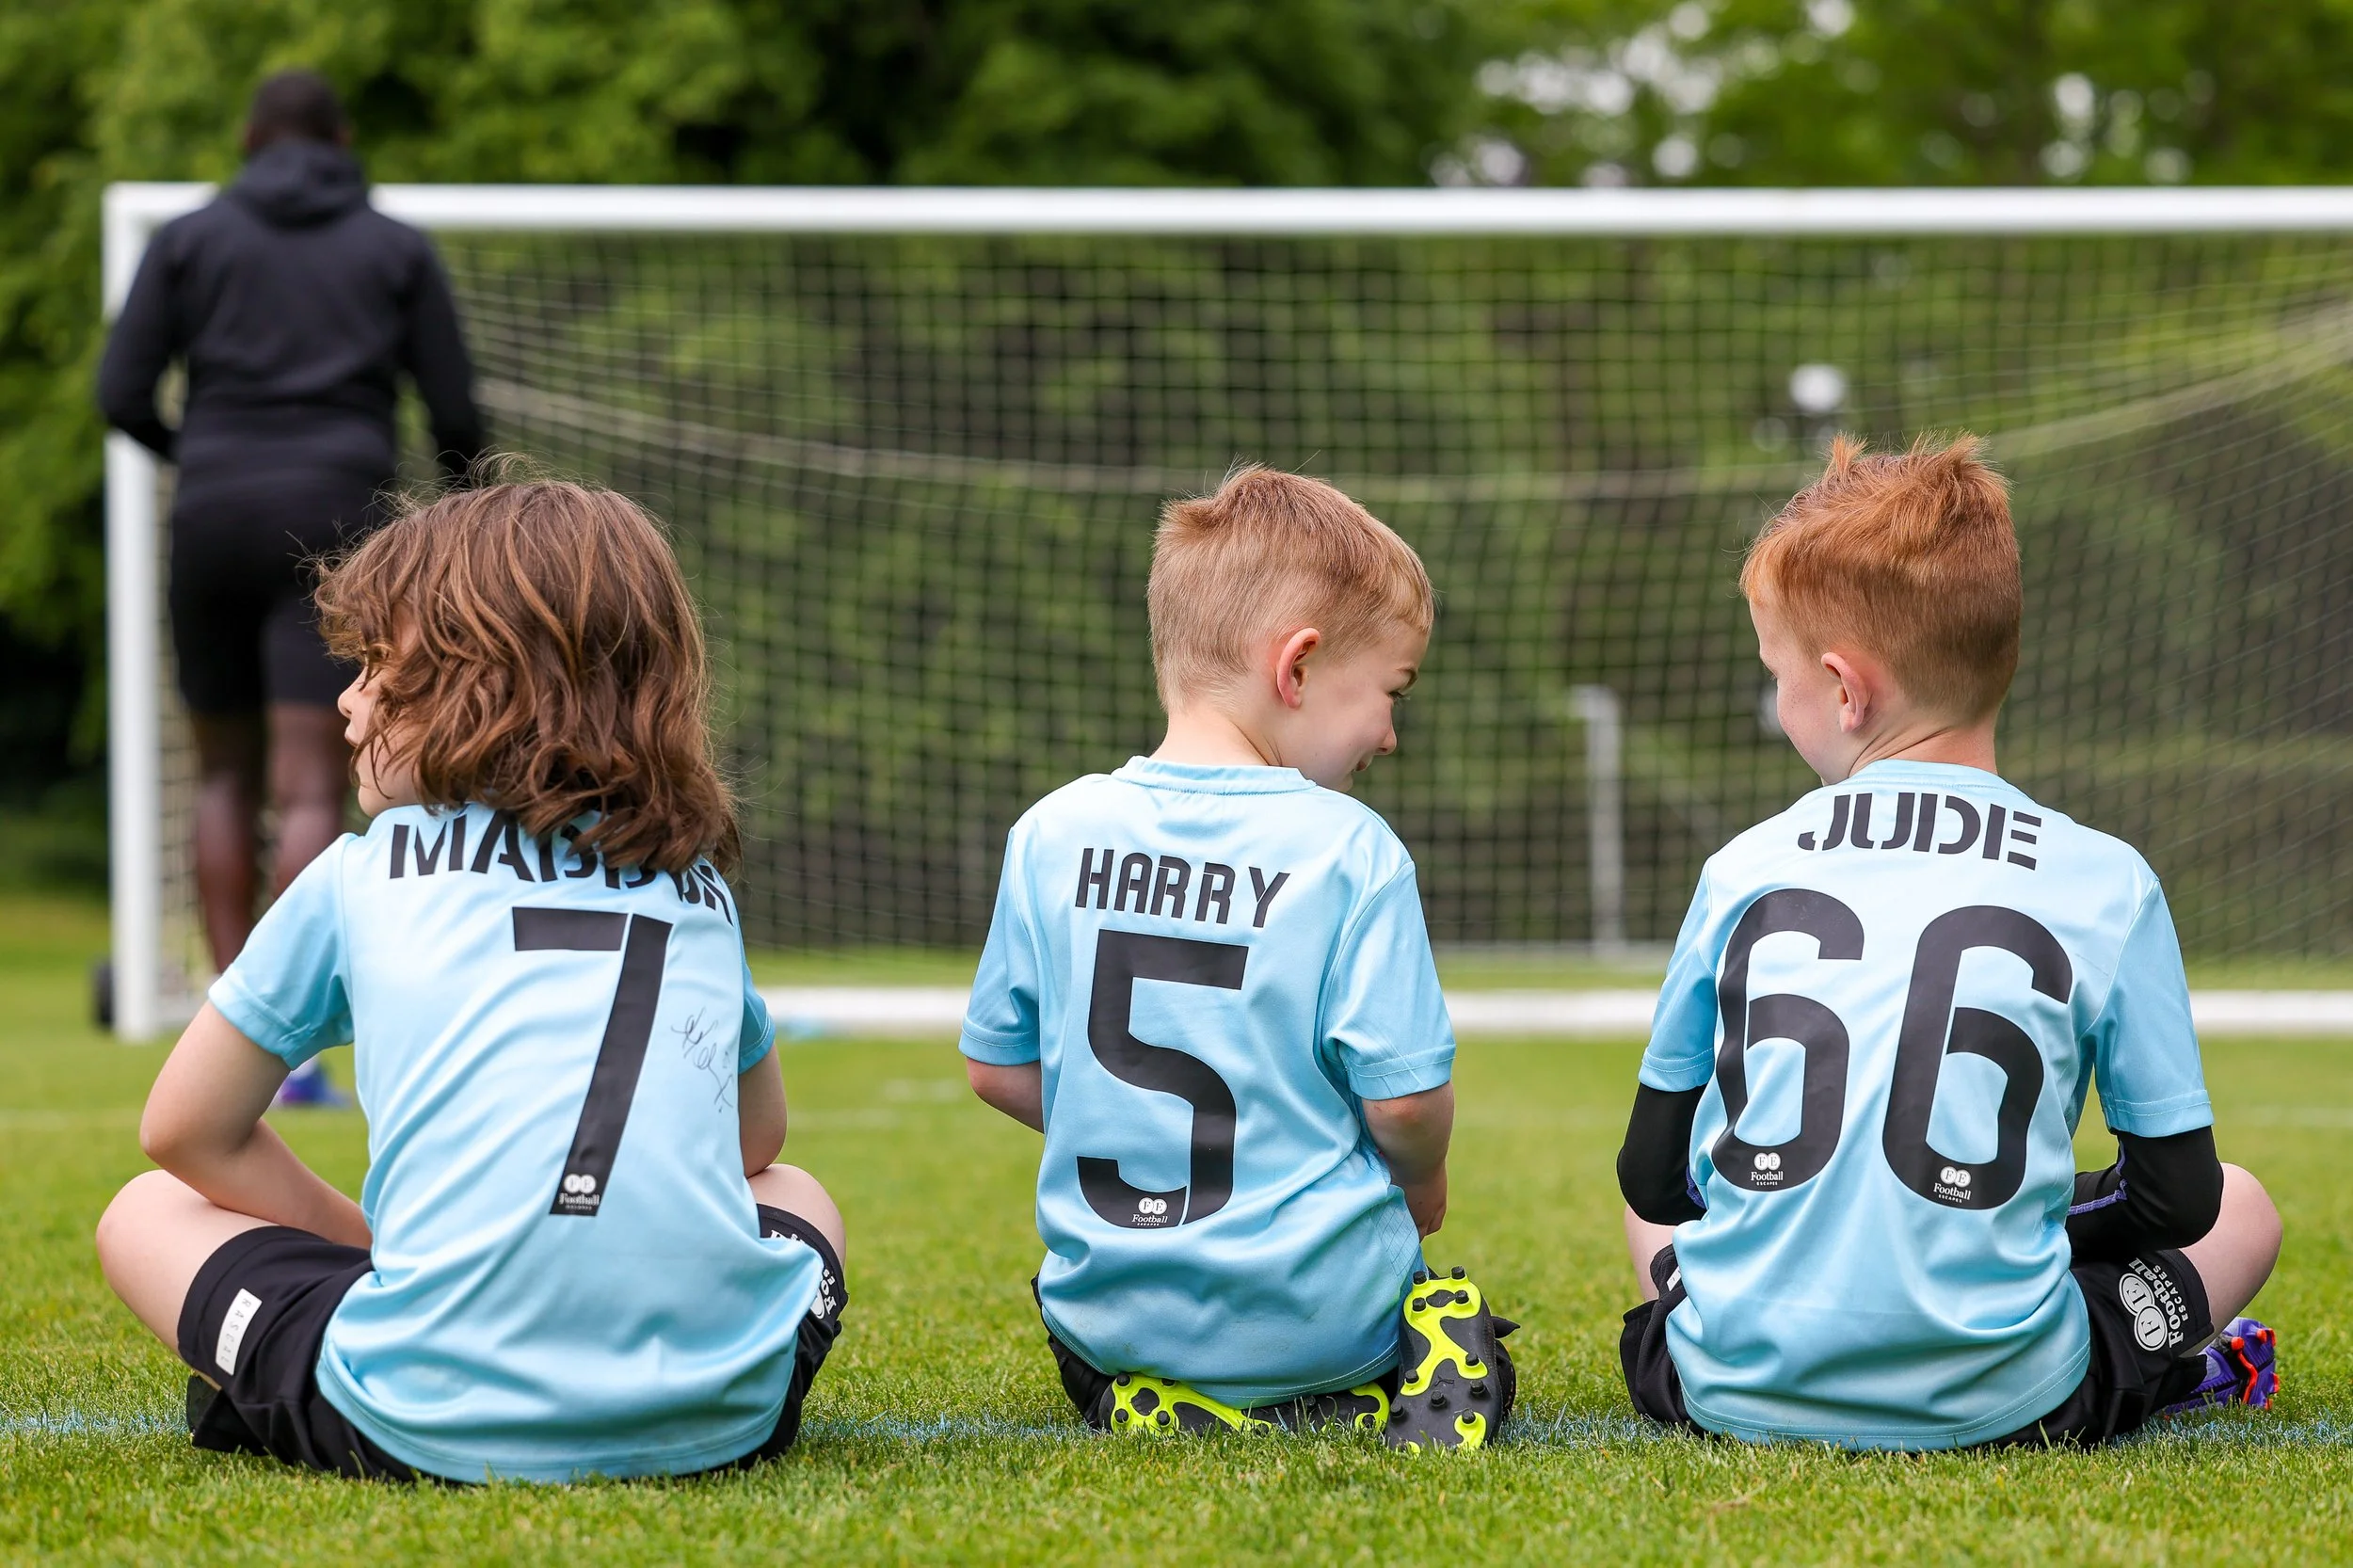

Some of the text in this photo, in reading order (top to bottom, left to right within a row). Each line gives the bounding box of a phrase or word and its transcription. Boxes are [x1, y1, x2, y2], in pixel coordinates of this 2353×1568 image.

[1798, 792, 2041, 871] JUDE
[1075, 847, 1290, 928] HARRY
[512, 906, 673, 1216] 7
[1076, 928, 1248, 1229] 5
[1711, 888, 2073, 1210] 66
[1751, 1171, 1784, 1181] Football
[1933, 1183, 1972, 1200] Football
[1131, 1214, 1168, 1224] Football
[220, 1298, 252, 1363] RASCAL
[2128, 1257, 2184, 1348] Football
[2153, 1265, 2188, 1321] ESCAPES
